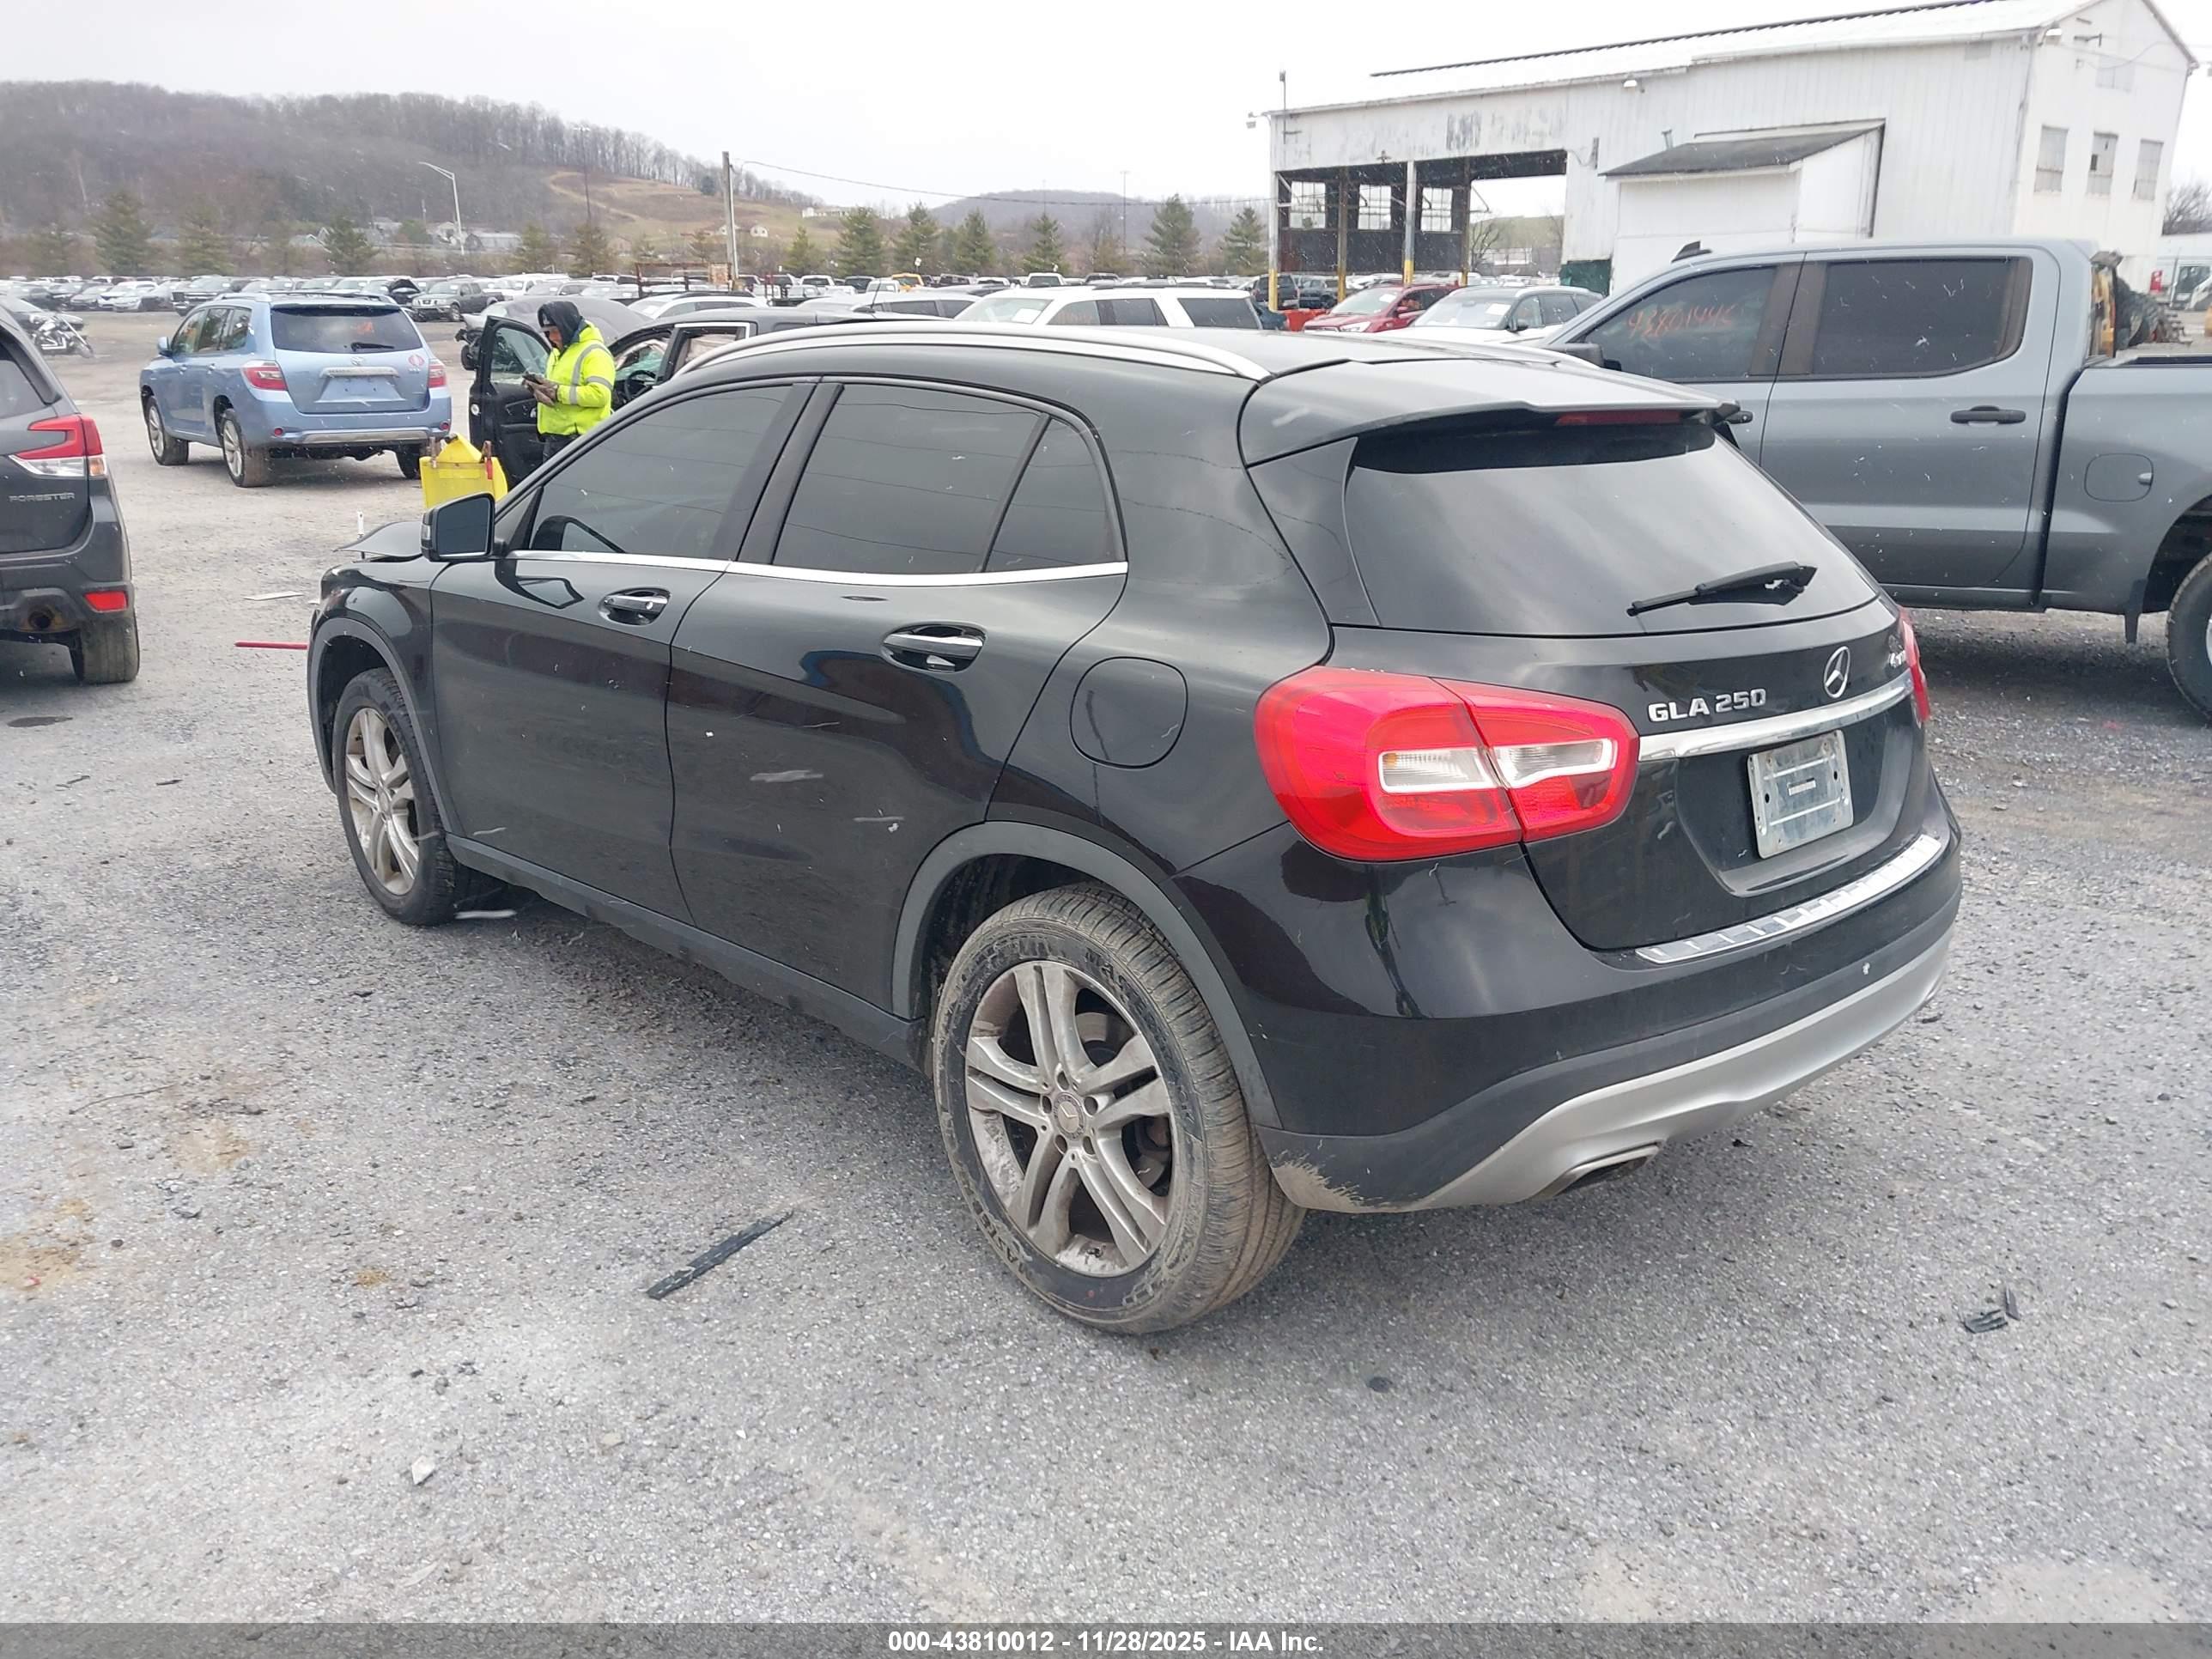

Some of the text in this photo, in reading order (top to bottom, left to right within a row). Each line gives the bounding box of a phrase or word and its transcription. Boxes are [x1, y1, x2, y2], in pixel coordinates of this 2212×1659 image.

[8, 492, 75, 501] FORESTER
[1648, 688, 1767, 722] GLA 250
